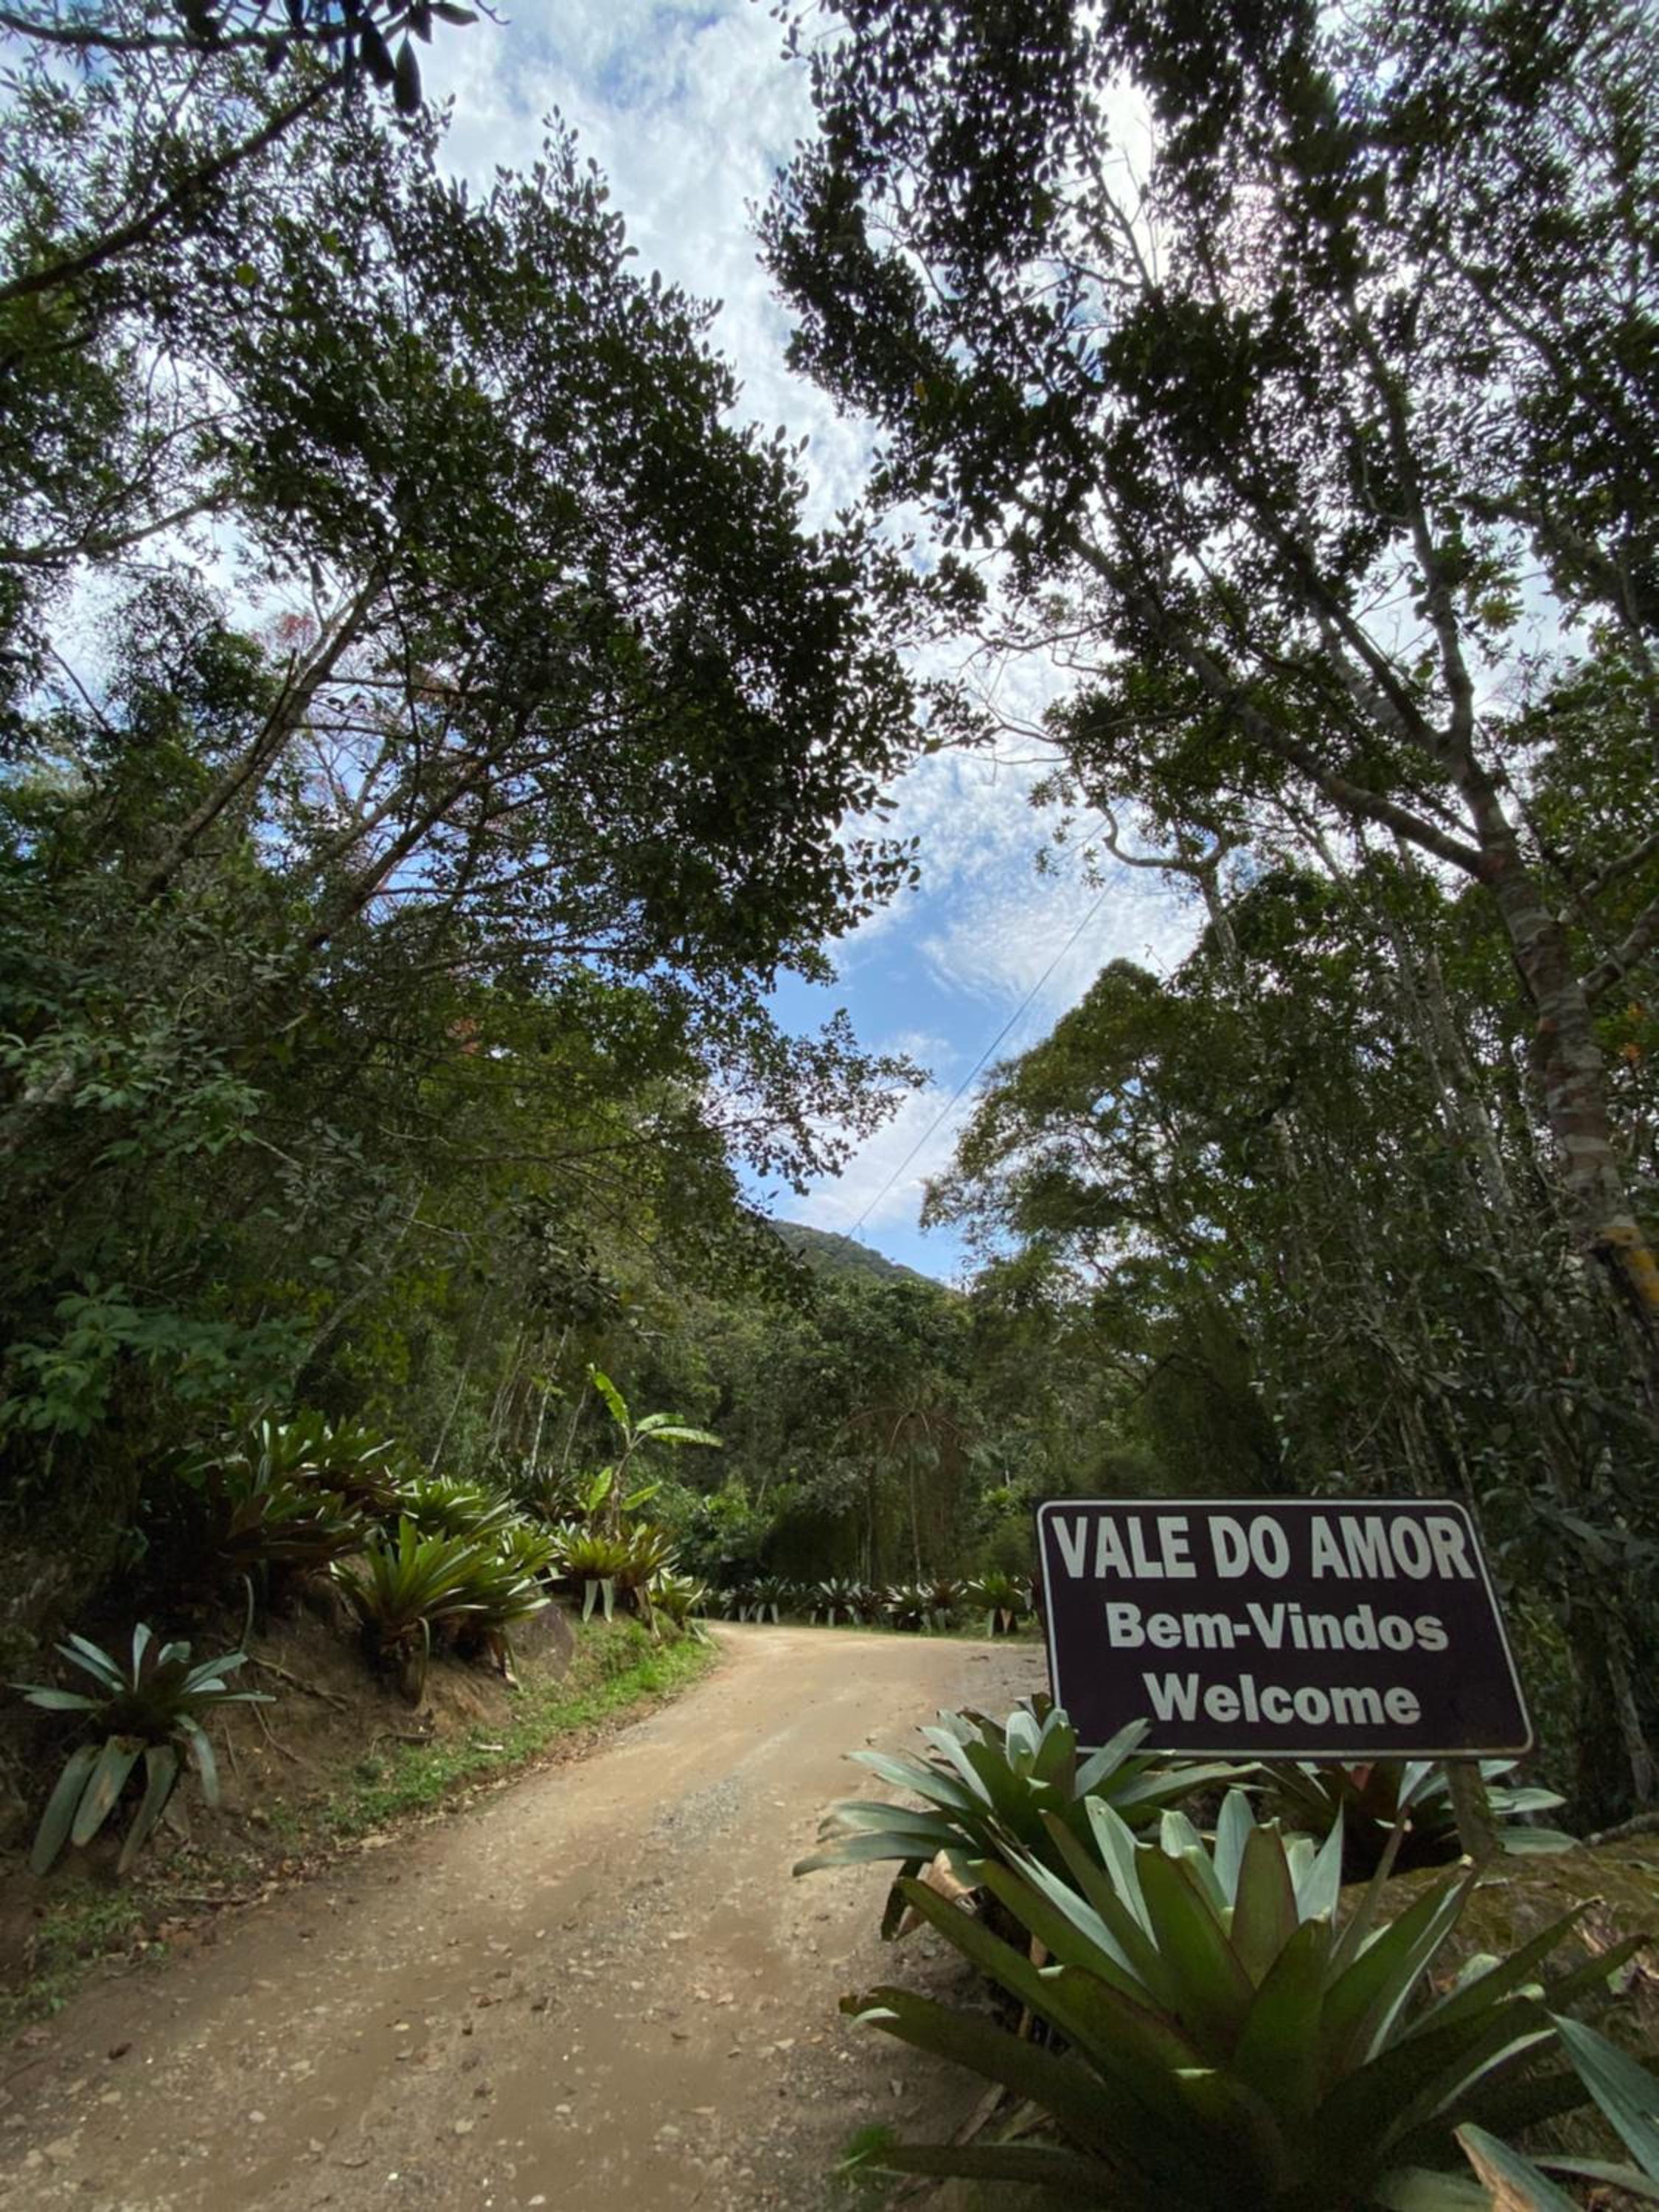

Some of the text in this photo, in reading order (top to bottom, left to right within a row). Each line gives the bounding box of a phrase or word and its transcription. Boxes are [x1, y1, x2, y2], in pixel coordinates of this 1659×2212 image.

[1052, 1516, 1475, 1579] VALE DO AMOR
[1106, 1603, 1449, 1650] Bem-Vindos
[1143, 1673, 1421, 1724] Welcome
